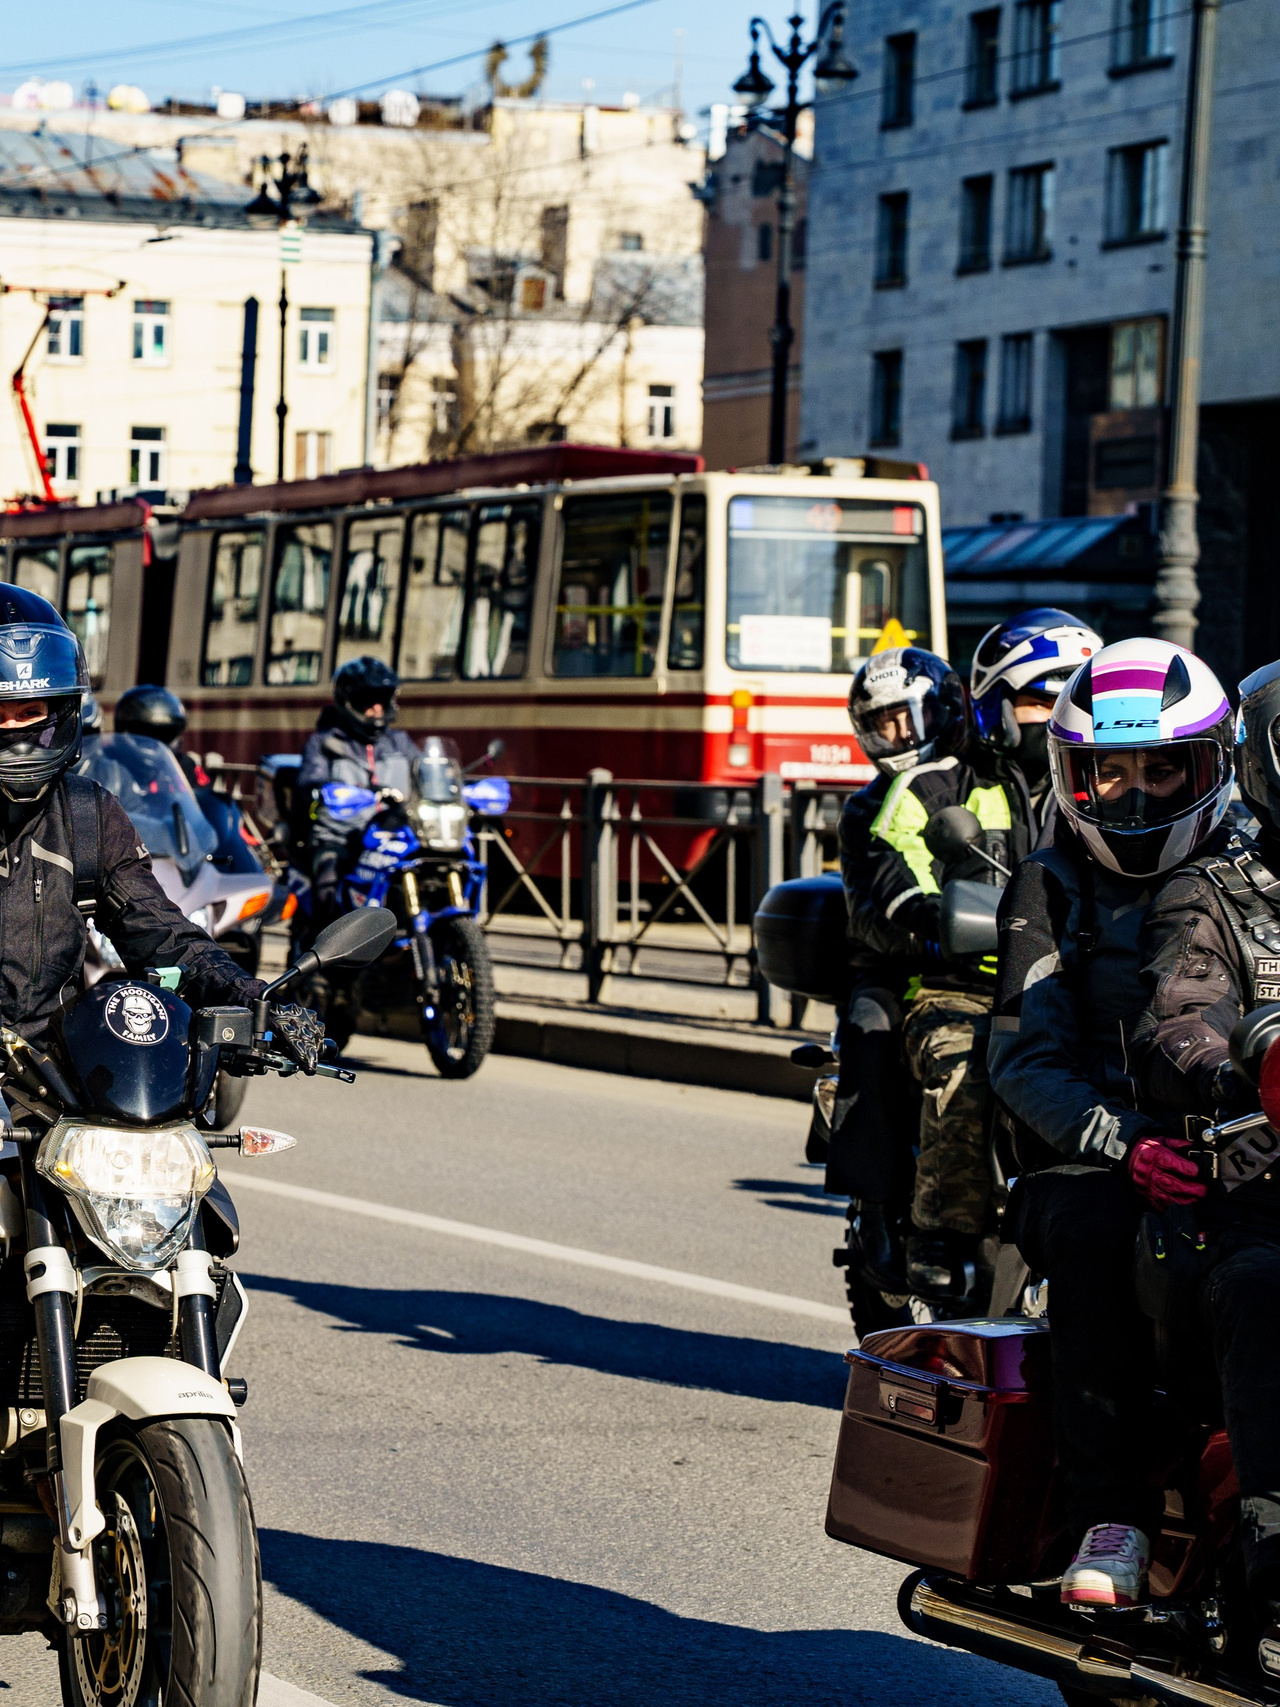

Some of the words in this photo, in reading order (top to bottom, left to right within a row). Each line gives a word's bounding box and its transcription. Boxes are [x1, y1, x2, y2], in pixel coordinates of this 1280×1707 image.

[1094, 719, 1160, 731] LS2
[1260, 961, 1280, 972] TH
[108, 996, 121, 1015] THE
[120, 988, 167, 1020] HOOLIGANS
[122, 1029, 157, 1042] FAMILY
[177, 1390, 214, 1400] aprilia
